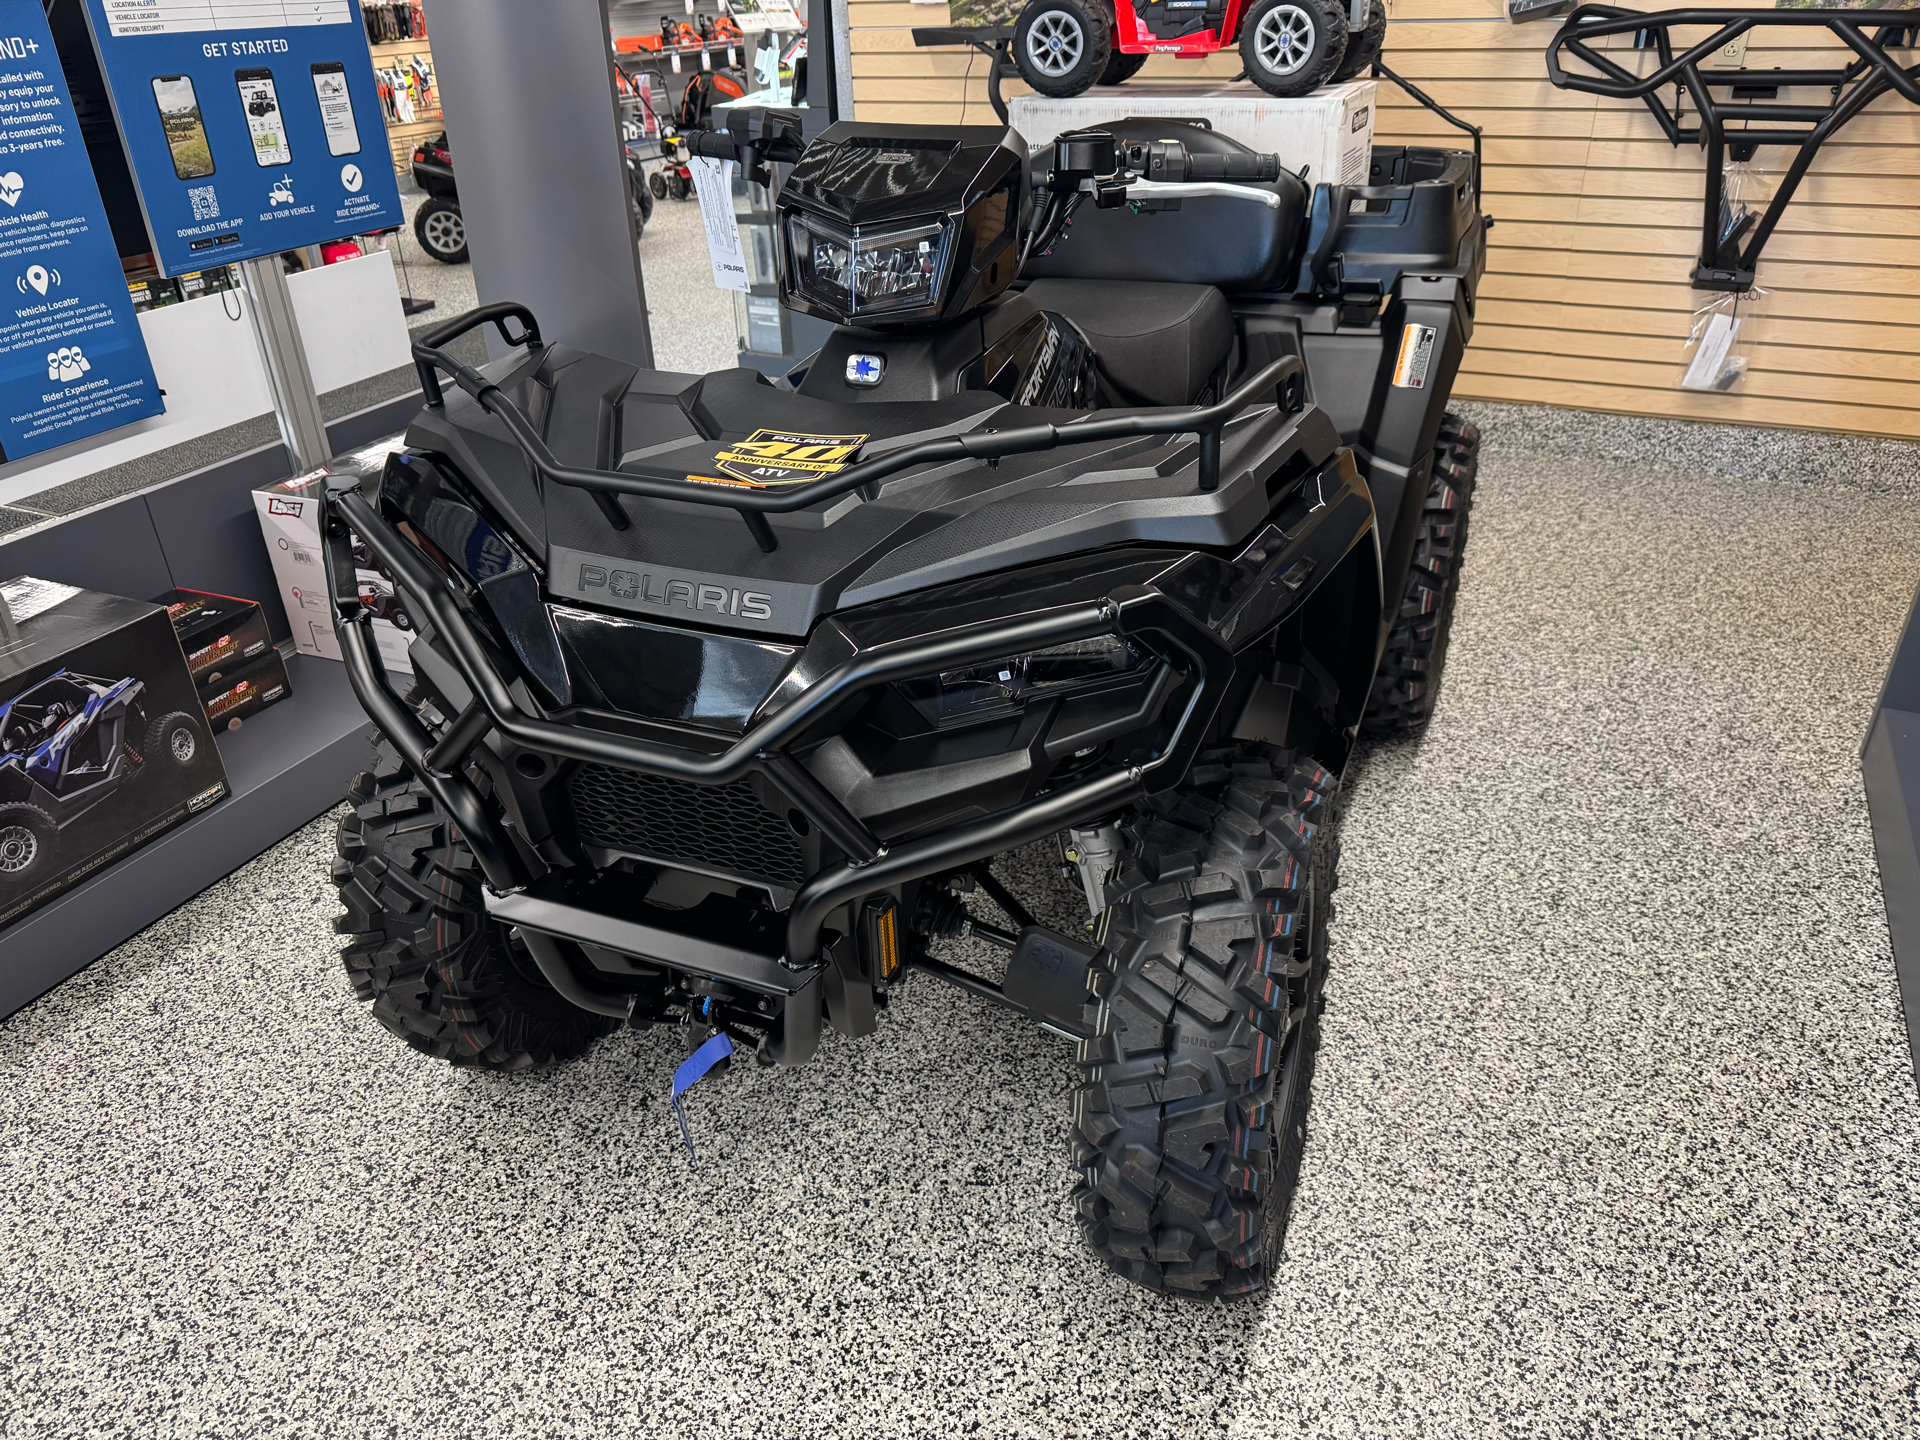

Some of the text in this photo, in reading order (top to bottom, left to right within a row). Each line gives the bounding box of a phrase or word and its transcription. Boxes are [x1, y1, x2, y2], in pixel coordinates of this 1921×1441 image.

[115, 13, 137, 21] VEHICLE
[118, 24, 165, 33] IGNITION SECURITY
[0, 37, 39, 60] ND+
[202, 38, 289, 58] GET STARTED
[24, 70, 45, 81] with
[8, 86, 34, 97] equip
[35, 84, 54, 96] your
[21, 101, 30, 109] to
[32, 96, 61, 107] unlock
[2, 112, 54, 126] information
[169, 116, 195, 124] POLARIS
[9, 123, 65, 139] connectivity.
[8, 141, 43, 153] 3-years
[44, 138, 65, 148] free.
[344, 194, 371, 206] ACTIVATE
[20, 210, 49, 223] Health
[259, 205, 316, 222] ADD YOUR VEHICLE
[336, 208, 350, 217] RIDE
[4, 227, 27, 237] vehicle
[28, 223, 50, 233] health,
[50, 216, 86, 229] diagnostics
[177, 217, 244, 238] DOWNLOAD THE APP
[15, 233, 50, 245] reminders,
[49, 229, 66, 239] keep
[65, 226, 80, 235] tabs
[80, 225, 89, 233] on
[22, 245, 39, 253] from
[39, 239, 72, 250] anywhere.
[723, 263, 745, 273] POLARIS
[15, 296, 80, 318] Vehicle Locator
[21, 317, 41, 329] where
[41, 315, 52, 324] any
[53, 309, 75, 320] vehicle
[75, 308, 86, 316] you
[86, 304, 99, 312] own
[3, 335, 10, 343] or
[11, 332, 21, 341] off
[21, 329, 35, 339] your
[36, 323, 64, 336] property
[64, 318, 76, 327] and
[75, 316, 84, 324] be
[84, 310, 107, 322] notified
[107, 309, 112, 317] if
[11, 339, 34, 350] vehicle
[34, 335, 48, 345] has
[48, 332, 62, 341] been
[62, 325, 87, 338] bumped
[94, 318, 116, 329] moved.
[42, 378, 110, 404] Rider Experience
[10, 379, 144, 424] Polaris owners receive the ultimate connected
[32, 393, 129, 427] experience with post ride reports,
[23, 425, 54, 439] automatic
[54, 419, 73, 431] Group
[73, 413, 90, 423] Ride+
[90, 409, 101, 418] and
[101, 404, 115, 415] Ride
[771, 435, 842, 445] POLARIS
[731, 441, 860, 462] 40
[730, 455, 813, 469] ANNIVERSARY
[750, 467, 791, 478] ATV
[578, 563, 772, 620] POLARIS
[48, 712, 89, 761] RZR
[189, 784, 222, 806] HORIZON
[67, 869, 81, 881] NEW
[32, 881, 62, 901] POWERED
[1180, 1034, 1218, 1049] DURO
